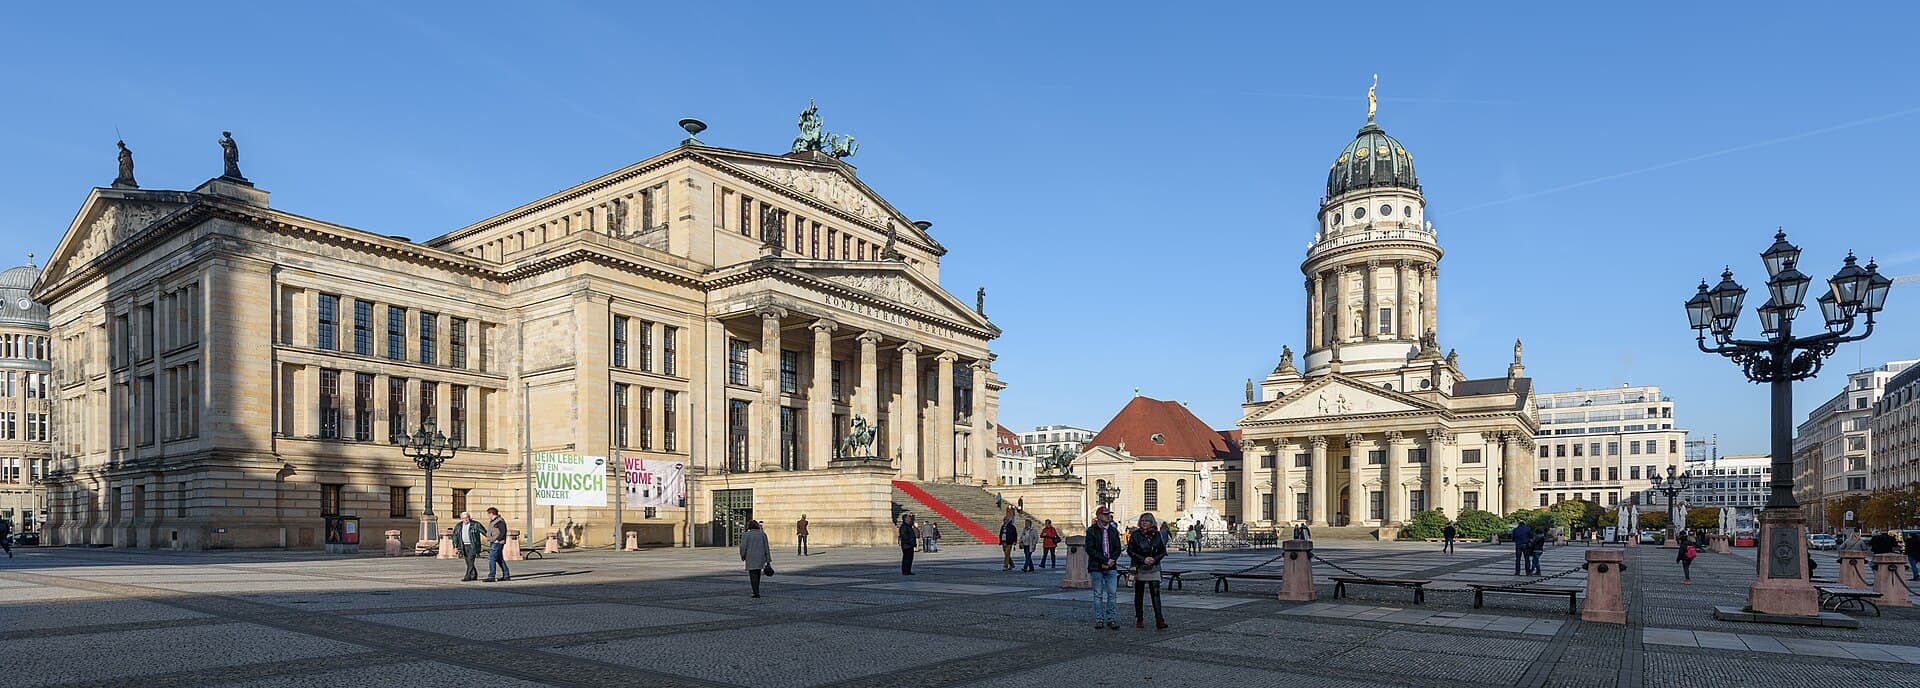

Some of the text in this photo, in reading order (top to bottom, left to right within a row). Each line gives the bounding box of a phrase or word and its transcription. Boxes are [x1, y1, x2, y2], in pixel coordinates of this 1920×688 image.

[825, 295, 954, 339] KONZERTHAUS BERLIN
[536, 451, 555, 463] DEIN
[558, 453, 584, 464] LEBEN
[624, 457, 646, 471] WEL
[536, 463, 545, 471] IST
[536, 472, 603, 491] WUNSCH
[625, 472, 653, 485] COME
